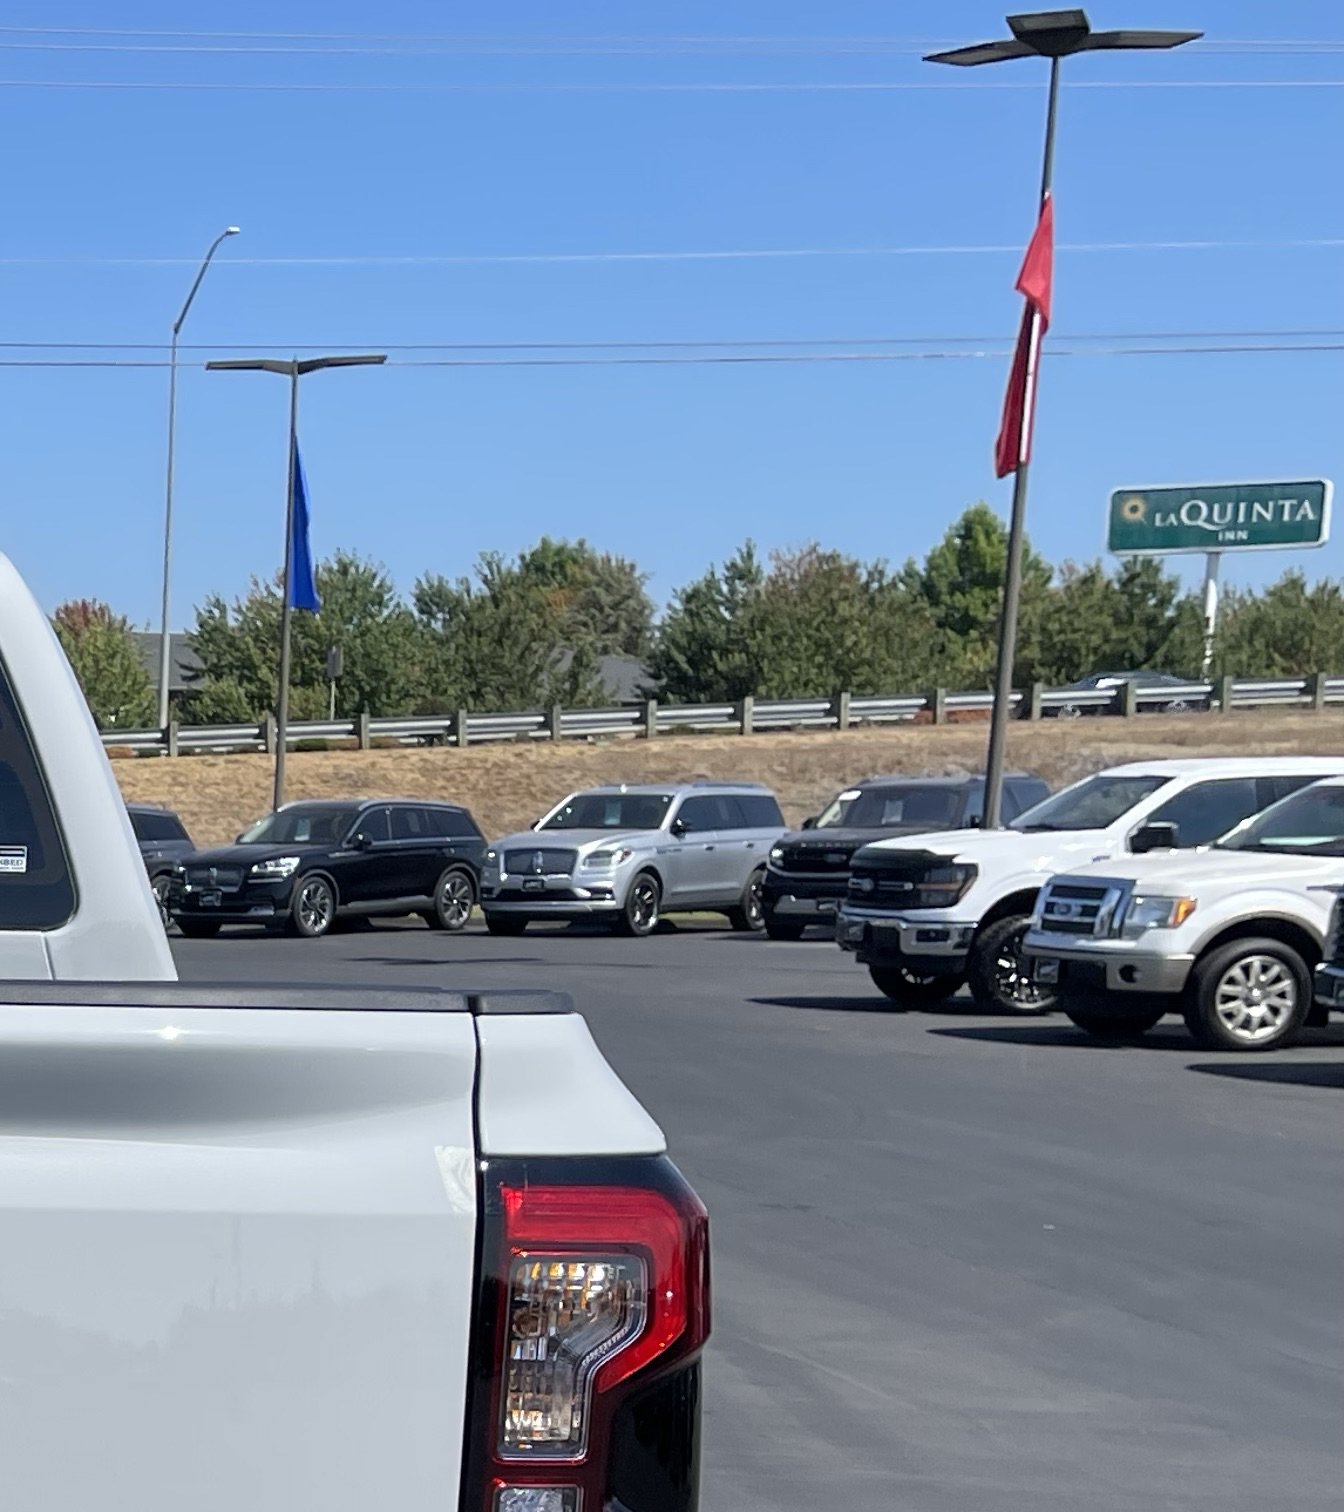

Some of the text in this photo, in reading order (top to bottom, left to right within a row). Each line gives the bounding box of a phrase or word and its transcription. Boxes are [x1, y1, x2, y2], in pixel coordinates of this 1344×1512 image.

[1155, 499, 1317, 531] LA QUINTA
[1218, 530, 1249, 542] INN
